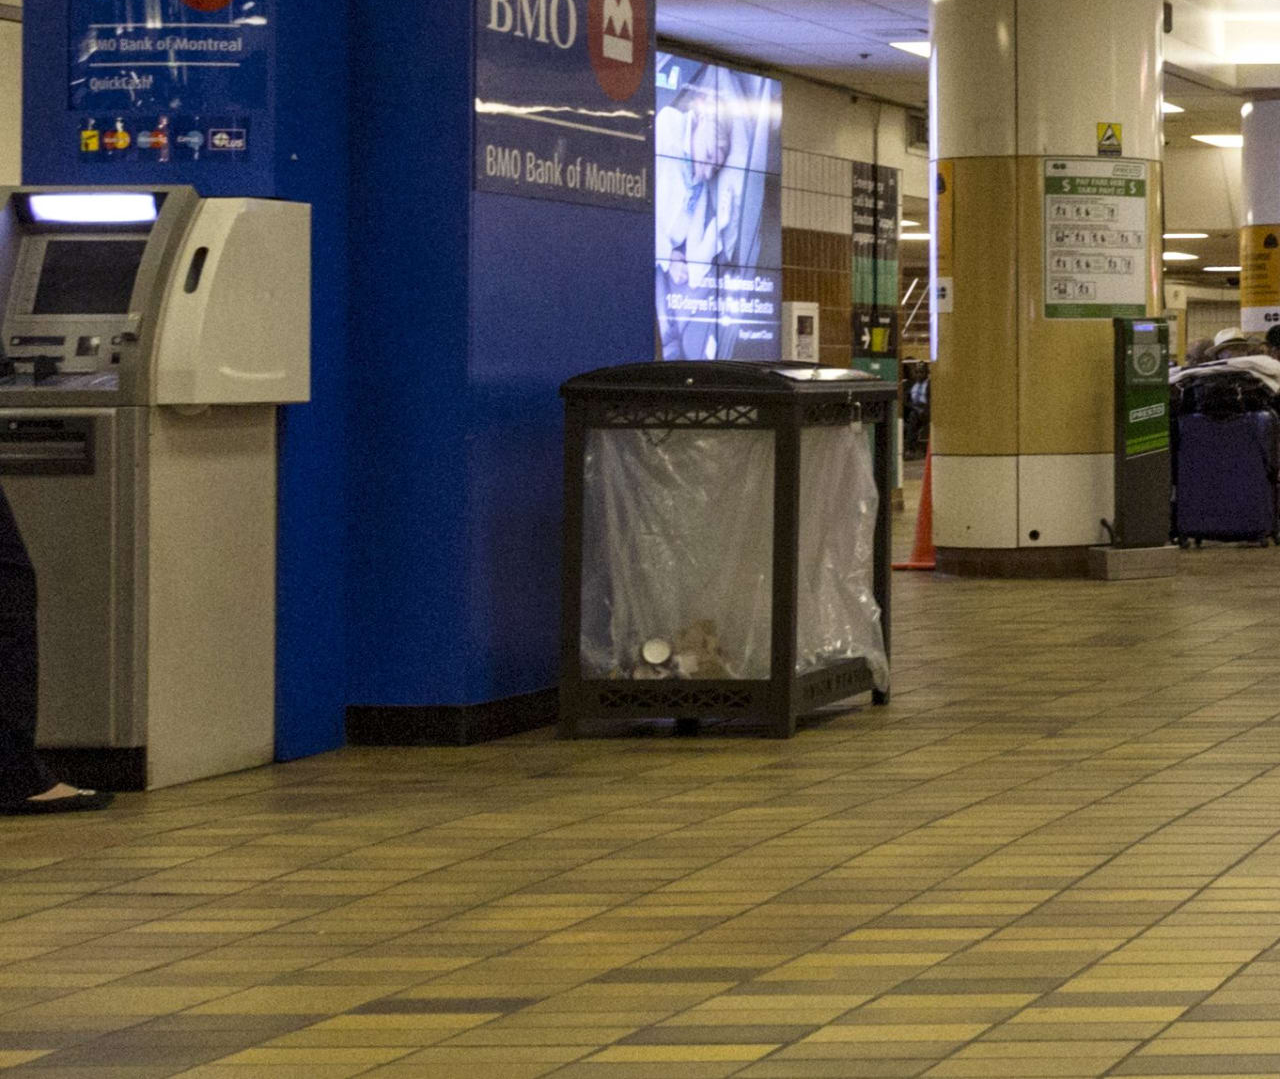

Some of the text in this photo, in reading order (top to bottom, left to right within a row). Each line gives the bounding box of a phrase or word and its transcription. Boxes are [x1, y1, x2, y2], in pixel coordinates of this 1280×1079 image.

[120, 36, 152, 52] Bank
[156, 36, 172, 52] of
[174, 37, 243, 53] Montreal
[486, 144, 647, 200] BMO Bank of Montreal
